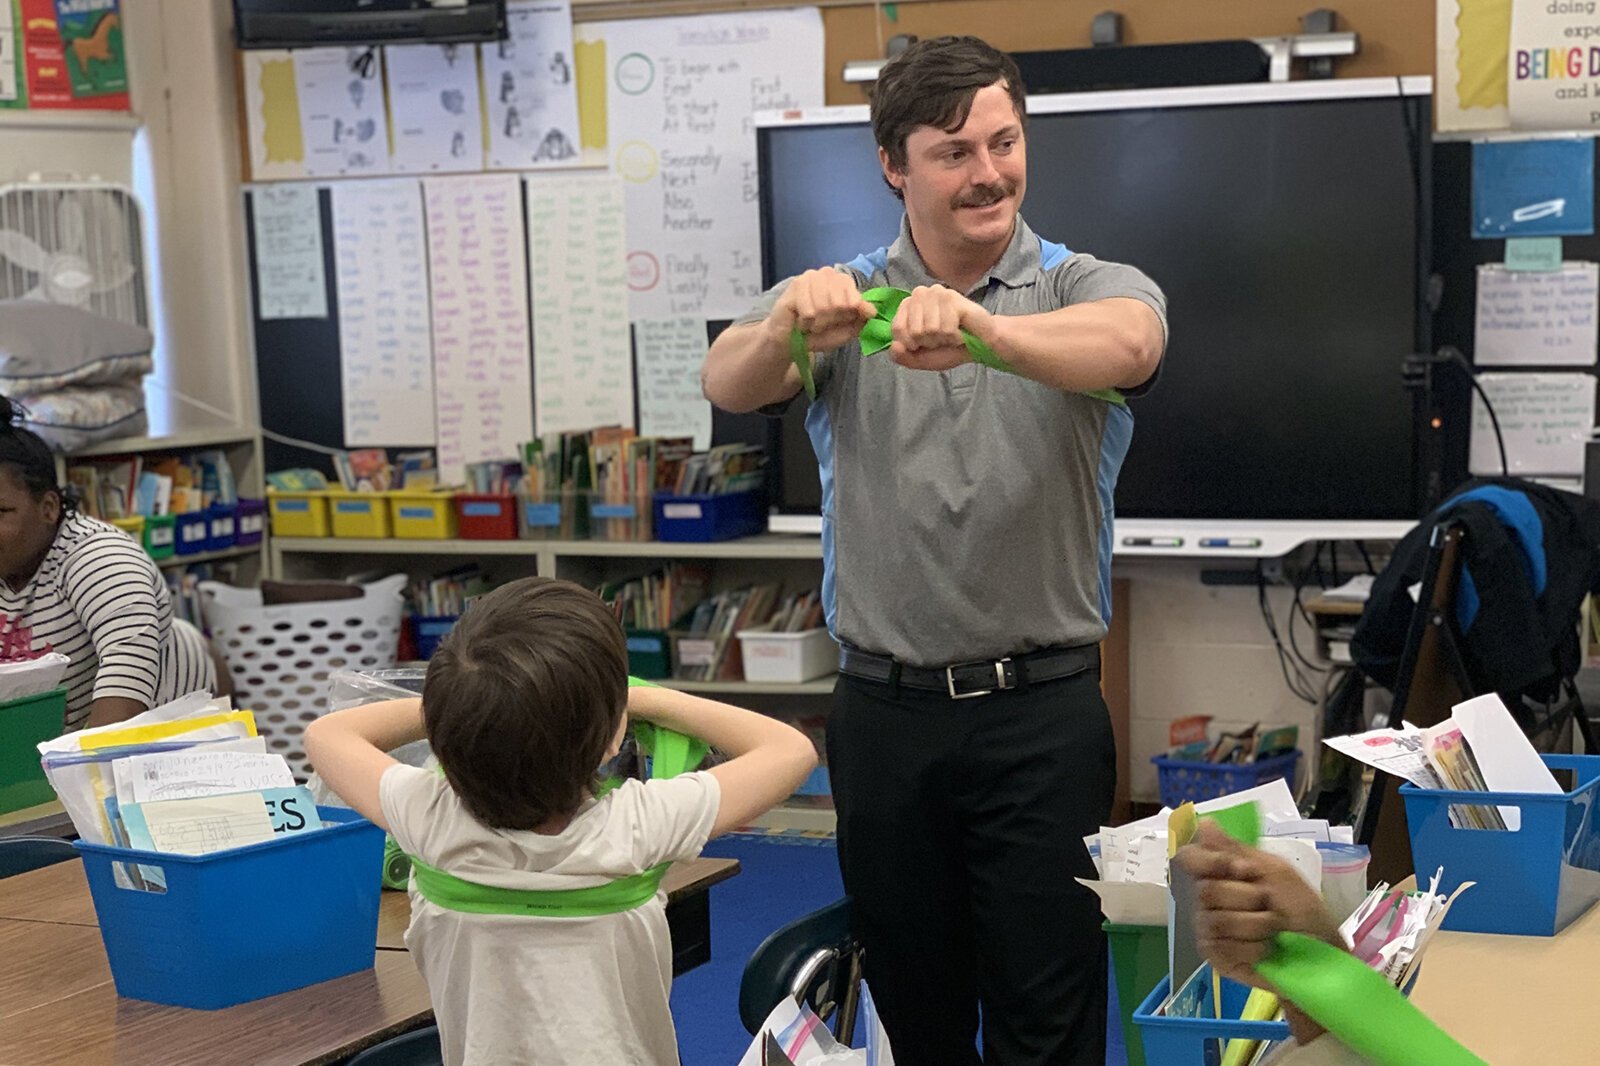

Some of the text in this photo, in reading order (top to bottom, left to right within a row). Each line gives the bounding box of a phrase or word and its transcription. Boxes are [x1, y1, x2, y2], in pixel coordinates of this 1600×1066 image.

[1547, 0, 1595, 14] doing
[659, 56, 740, 82] To begin with
[1516, 48, 1583, 80] BEING
[1555, 84, 1588, 99] and
[661, 146, 722, 173] Secondly
[661, 171, 697, 188] Next
[663, 191, 694, 211] Also
[663, 213, 714, 230] Another
[666, 253, 709, 278] Finally
[666, 277, 709, 298] Lastly
[671, 299, 702, 314] Last
